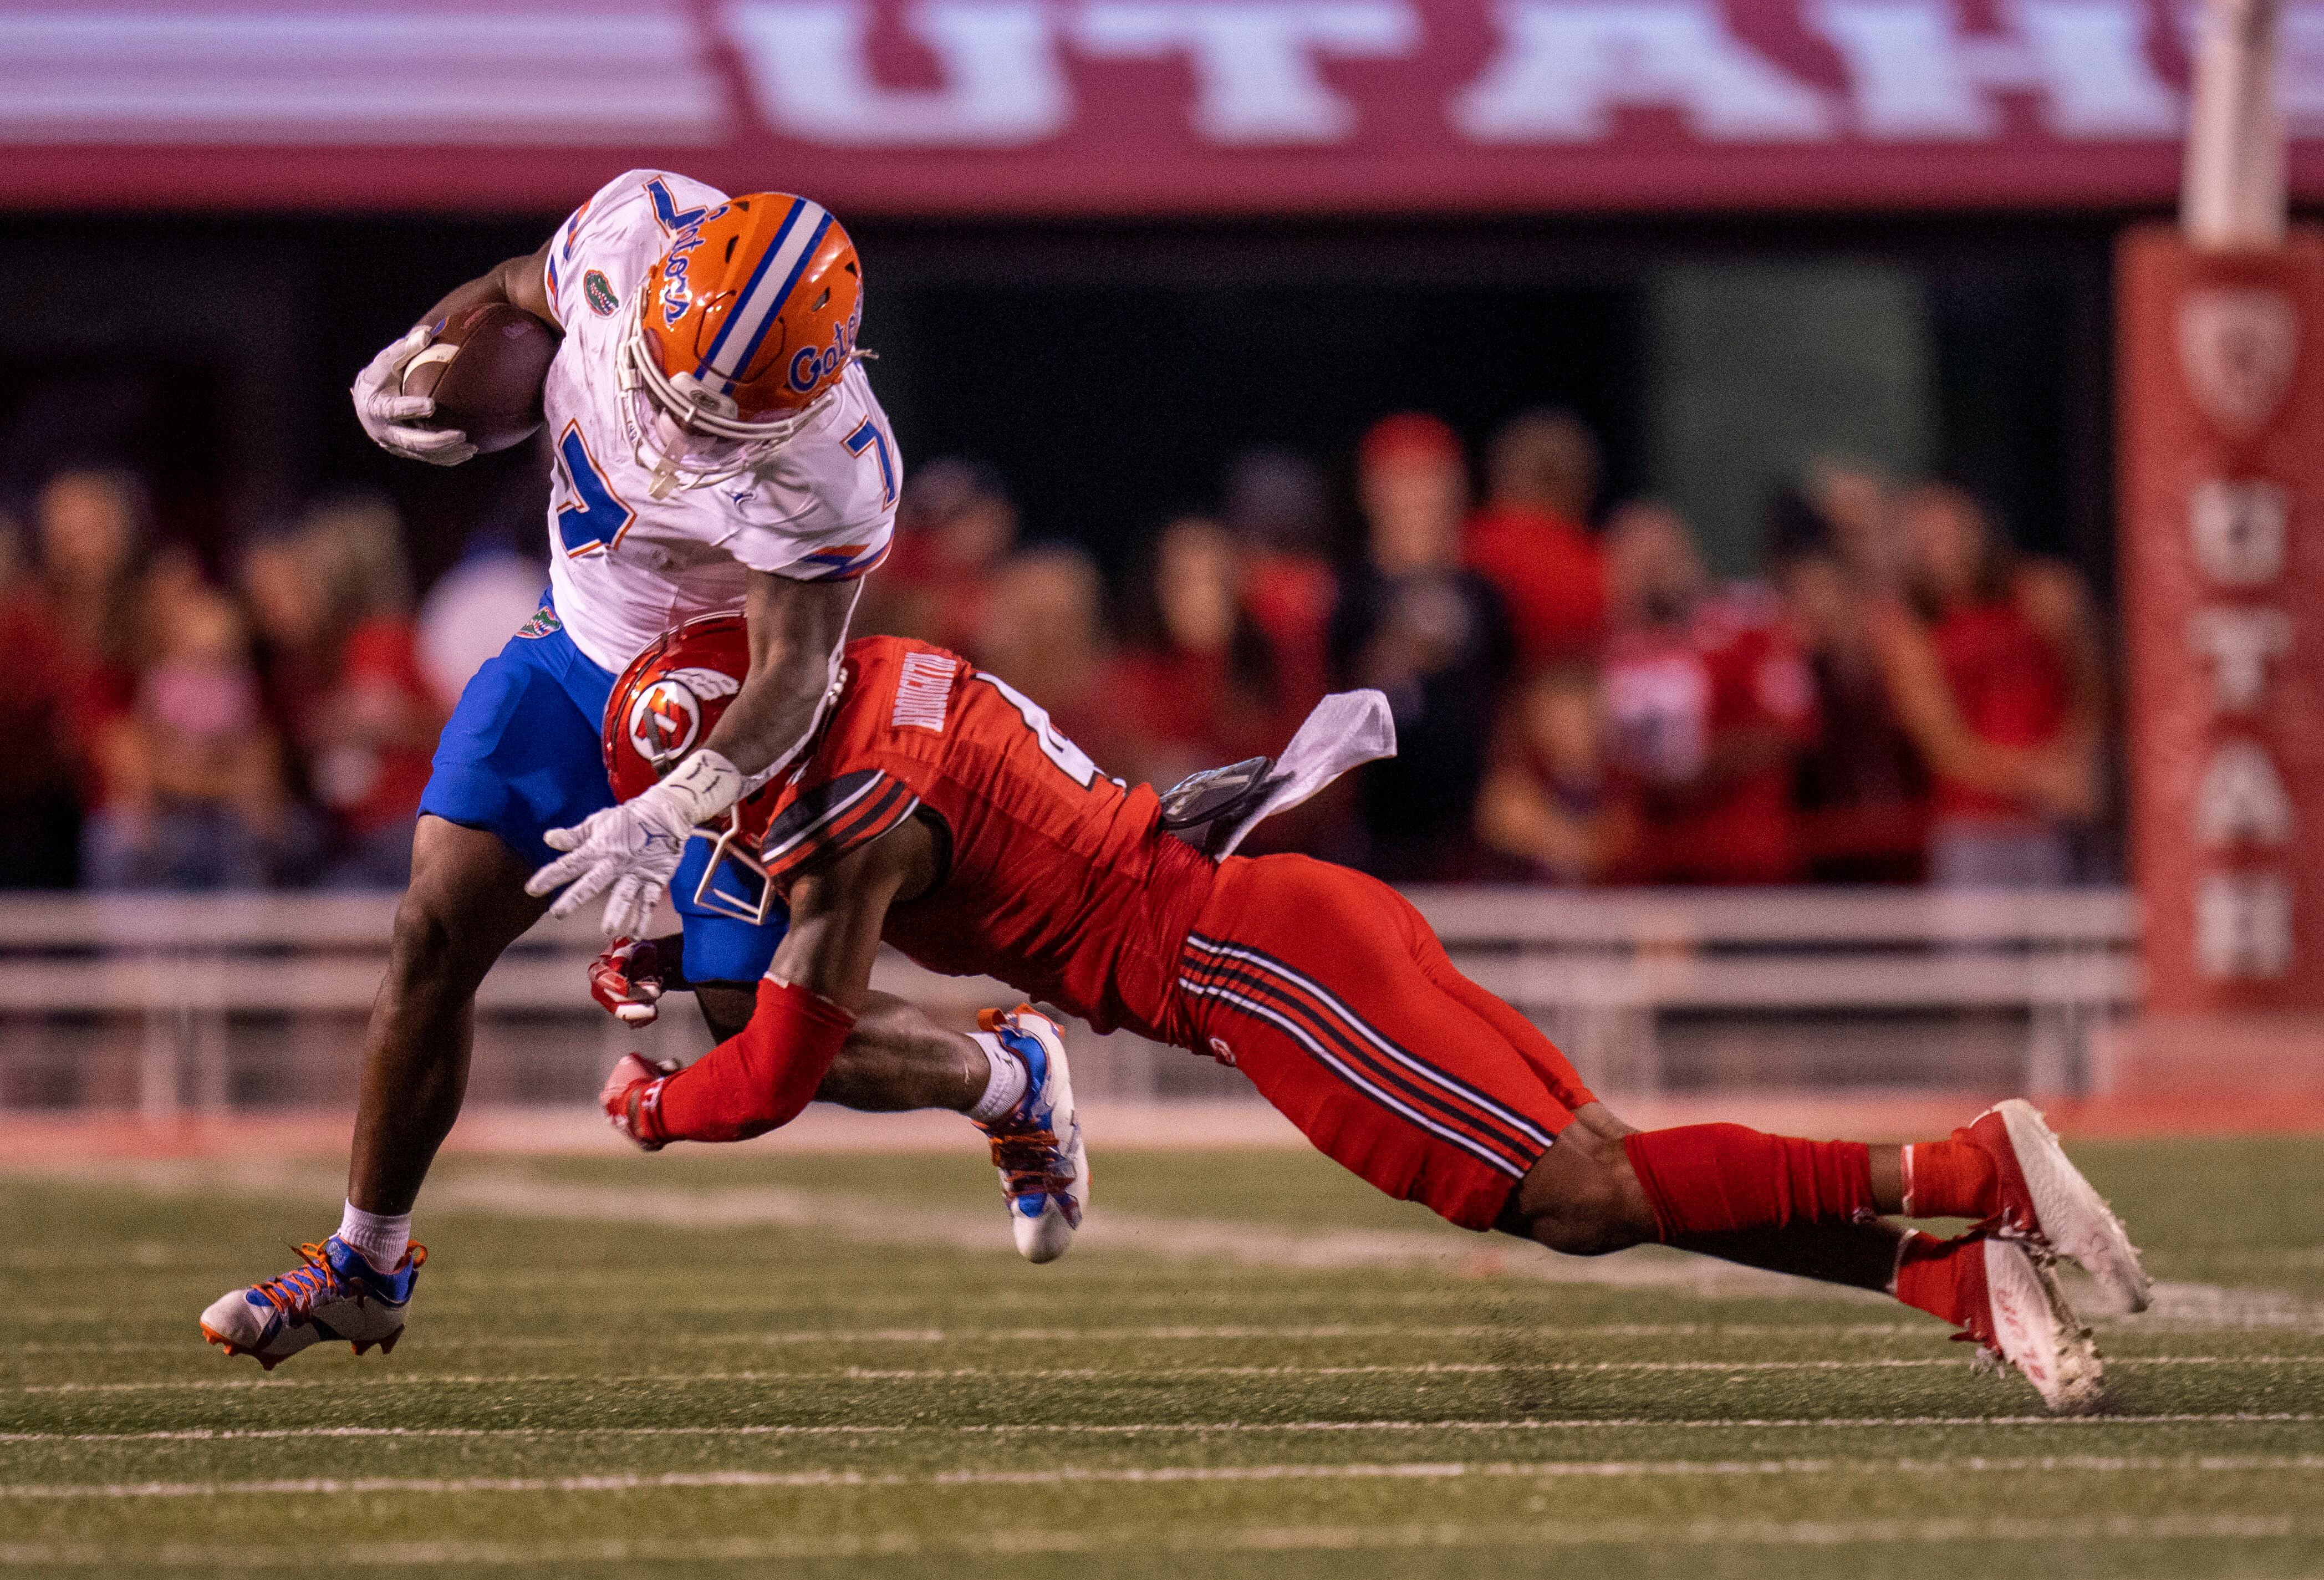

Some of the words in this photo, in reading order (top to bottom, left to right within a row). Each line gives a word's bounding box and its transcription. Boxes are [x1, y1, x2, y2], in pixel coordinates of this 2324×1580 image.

[723, 0, 2182, 142] UTAH
[840, 415, 898, 512] 7
[2187, 480, 2290, 981] UTAH
